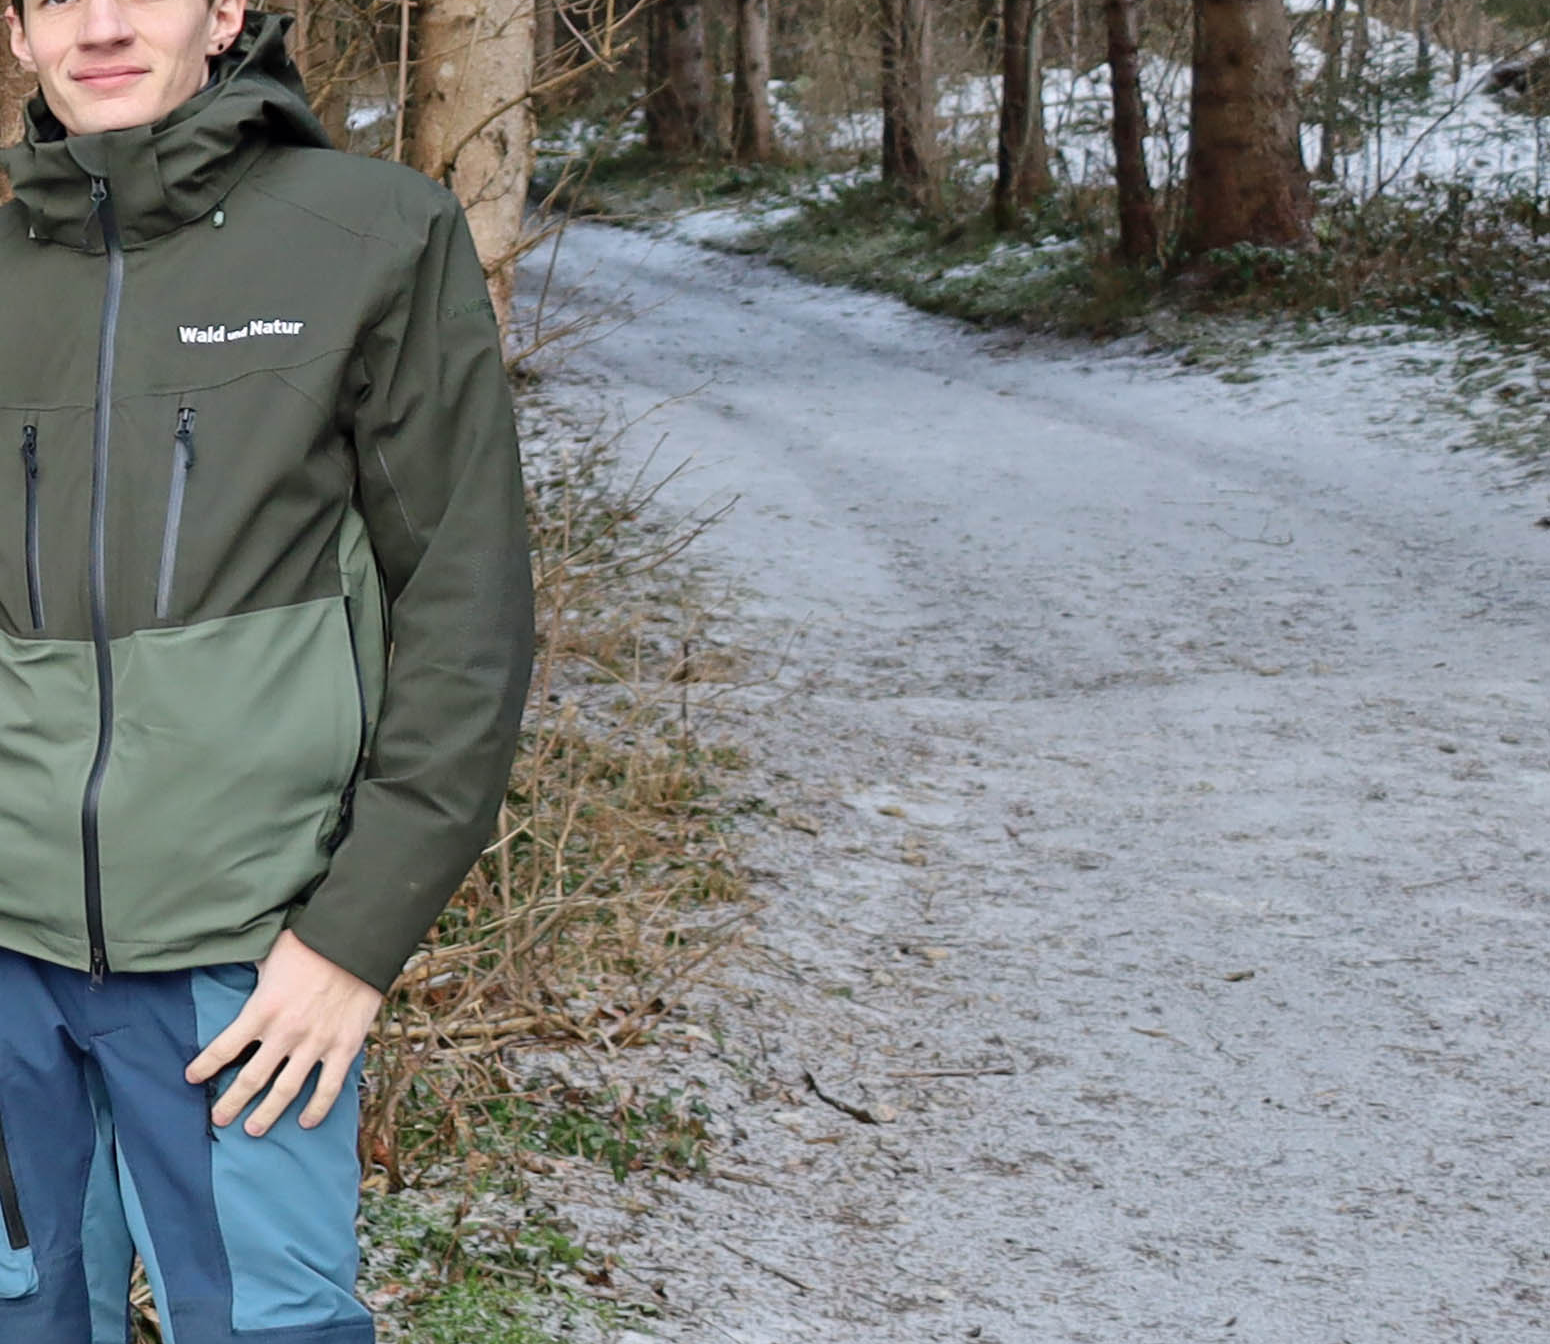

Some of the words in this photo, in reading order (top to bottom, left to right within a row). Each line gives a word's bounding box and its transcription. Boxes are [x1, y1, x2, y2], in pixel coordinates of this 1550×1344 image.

[178, 325, 226, 343] Wald
[226, 326, 248, 341] und
[249, 319, 304, 336] Natur
